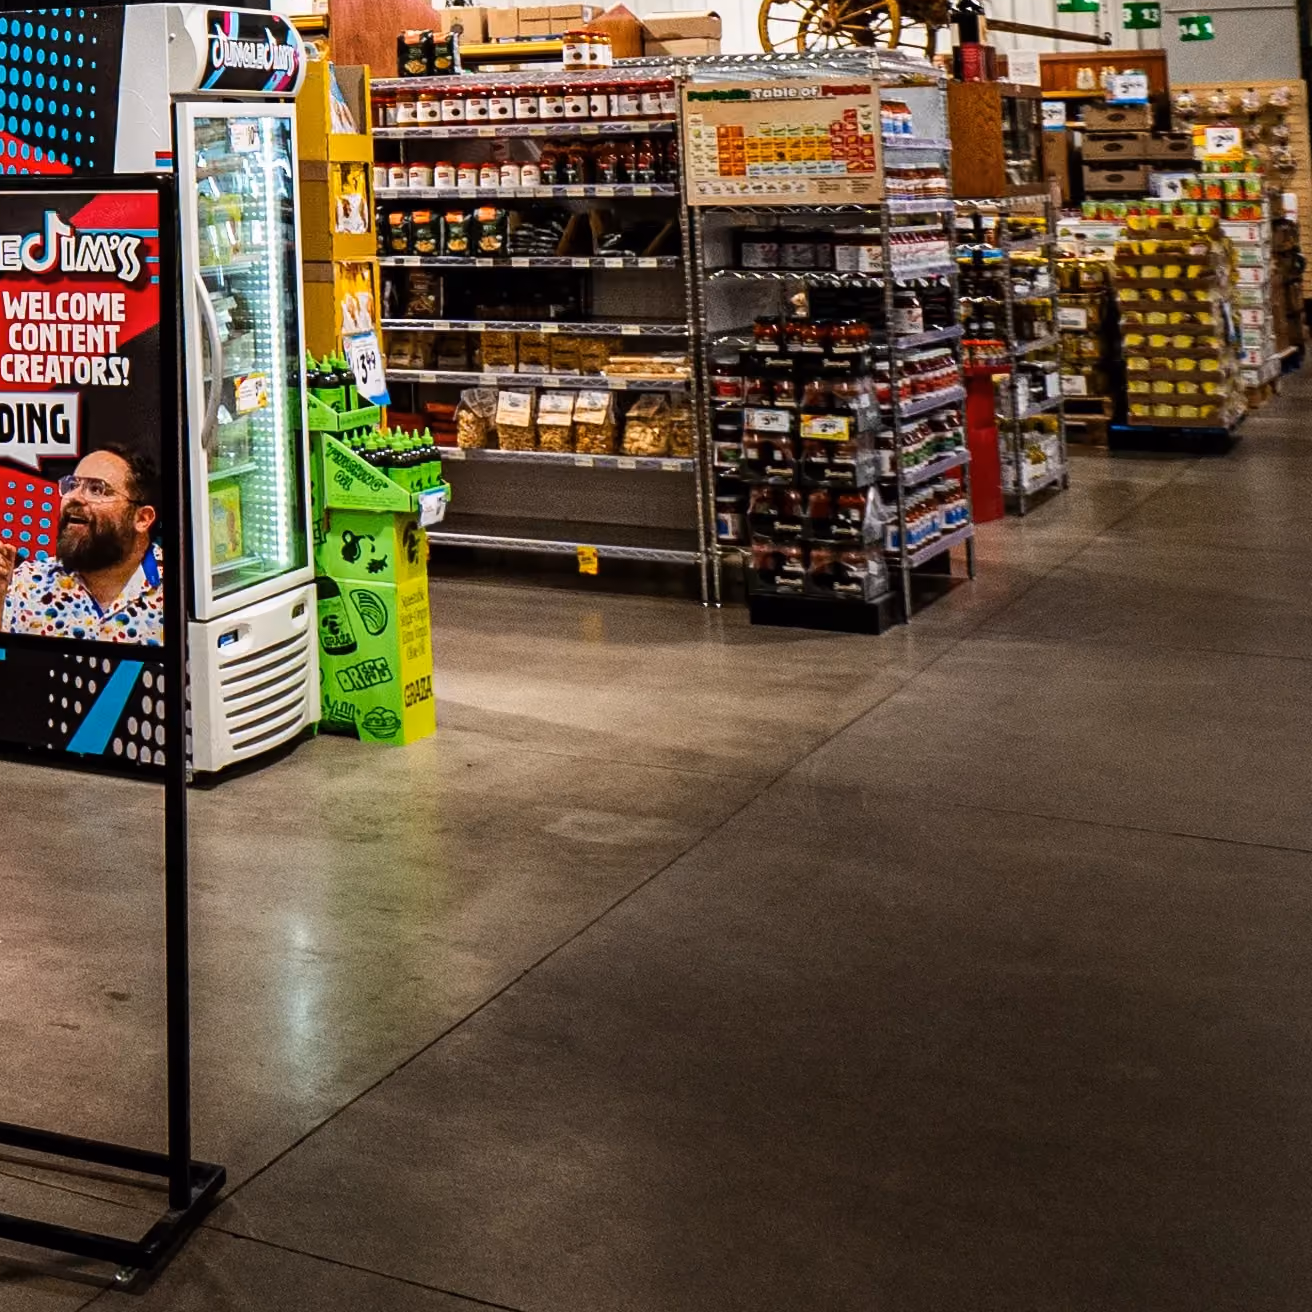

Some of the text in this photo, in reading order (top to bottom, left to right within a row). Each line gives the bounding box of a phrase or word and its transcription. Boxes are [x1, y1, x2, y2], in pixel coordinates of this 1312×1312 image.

[1142, 7, 1160, 22] 13
[753, 87, 796, 98] Table
[801, 86, 818, 97] of
[2, 290, 125, 322] WELCOME
[8, 323, 120, 353] CONTENT
[0, 355, 130, 386] CREATORS!
[404, 675, 433, 708] GRAZA
